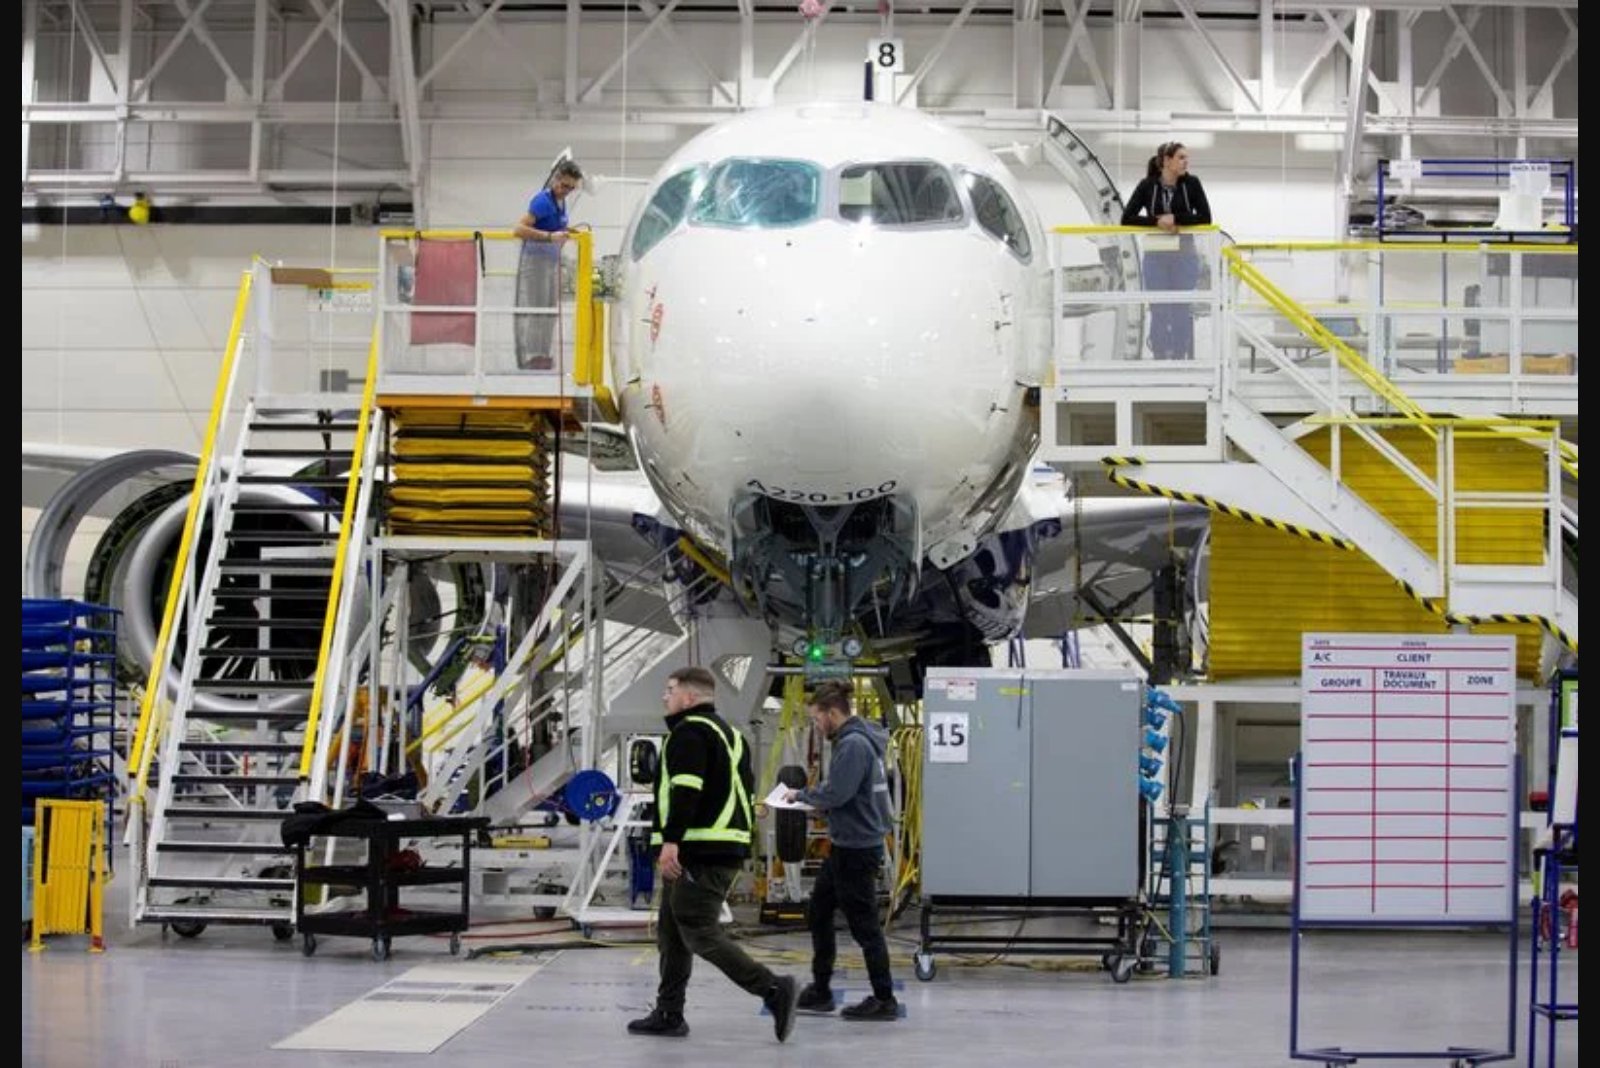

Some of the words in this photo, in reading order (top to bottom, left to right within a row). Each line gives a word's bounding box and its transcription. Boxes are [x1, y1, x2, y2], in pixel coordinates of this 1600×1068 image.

[879, 42, 896, 67] 8
[747, 479, 897, 502] A220-100
[1313, 653, 1331, 662] A/C
[1396, 653, 1431, 663] CLIENT
[1383, 671, 1427, 679] TRAVAUX
[1321, 678, 1362, 687] GROUPE
[1383, 680, 1437, 689] DOCUMENT
[1467, 676, 1493, 685] ZONE
[933, 723, 965, 748] 15
